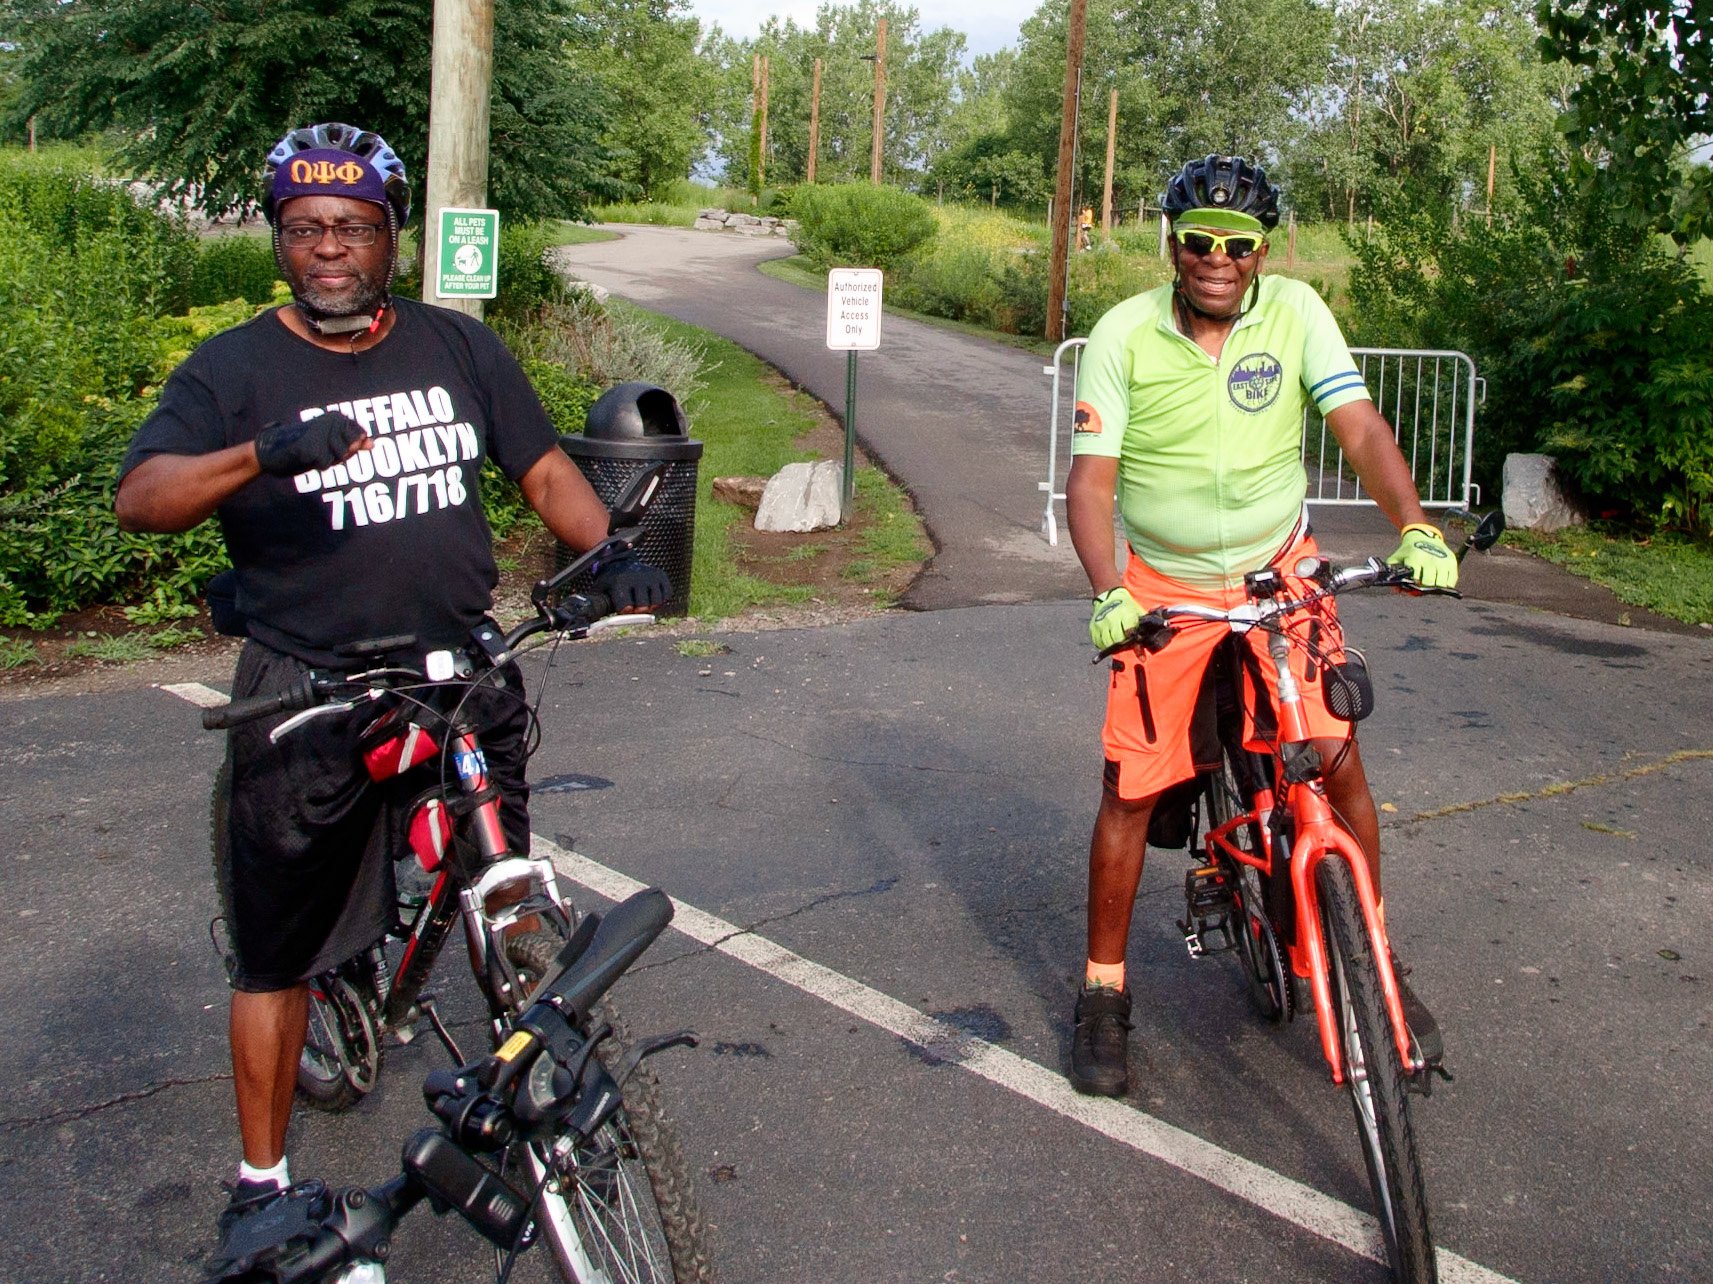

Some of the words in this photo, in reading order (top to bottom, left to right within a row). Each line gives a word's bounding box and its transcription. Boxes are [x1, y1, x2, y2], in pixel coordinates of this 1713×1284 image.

[291, 160, 364, 184] ΩΨΦ
[453, 217, 468, 226] ALL
[469, 218, 486, 227] PETS
[454, 226, 474, 235] MUST
[475, 227, 485, 236] BE
[448, 235, 460, 244] ON
[461, 235, 467, 244] A
[467, 236, 489, 245] LEASH
[443, 274, 466, 282] PLEASE
[466, 274, 484, 282] CLEAN
[484, 274, 492, 282] UP
[444, 282, 464, 290] AFTER
[464, 282, 479, 290] YOUR
[479, 282, 490, 290] PET
[834, 282, 878, 292] Authorized
[841, 297, 869, 306] Vehicle
[841, 311, 869, 320] Access
[845, 324, 863, 336] Only
[1233, 383, 1248, 391] EAST
[1246, 386, 1268, 400] BIKE
[300, 386, 454, 437] FFALO
[322, 465, 467, 531] 716/718
